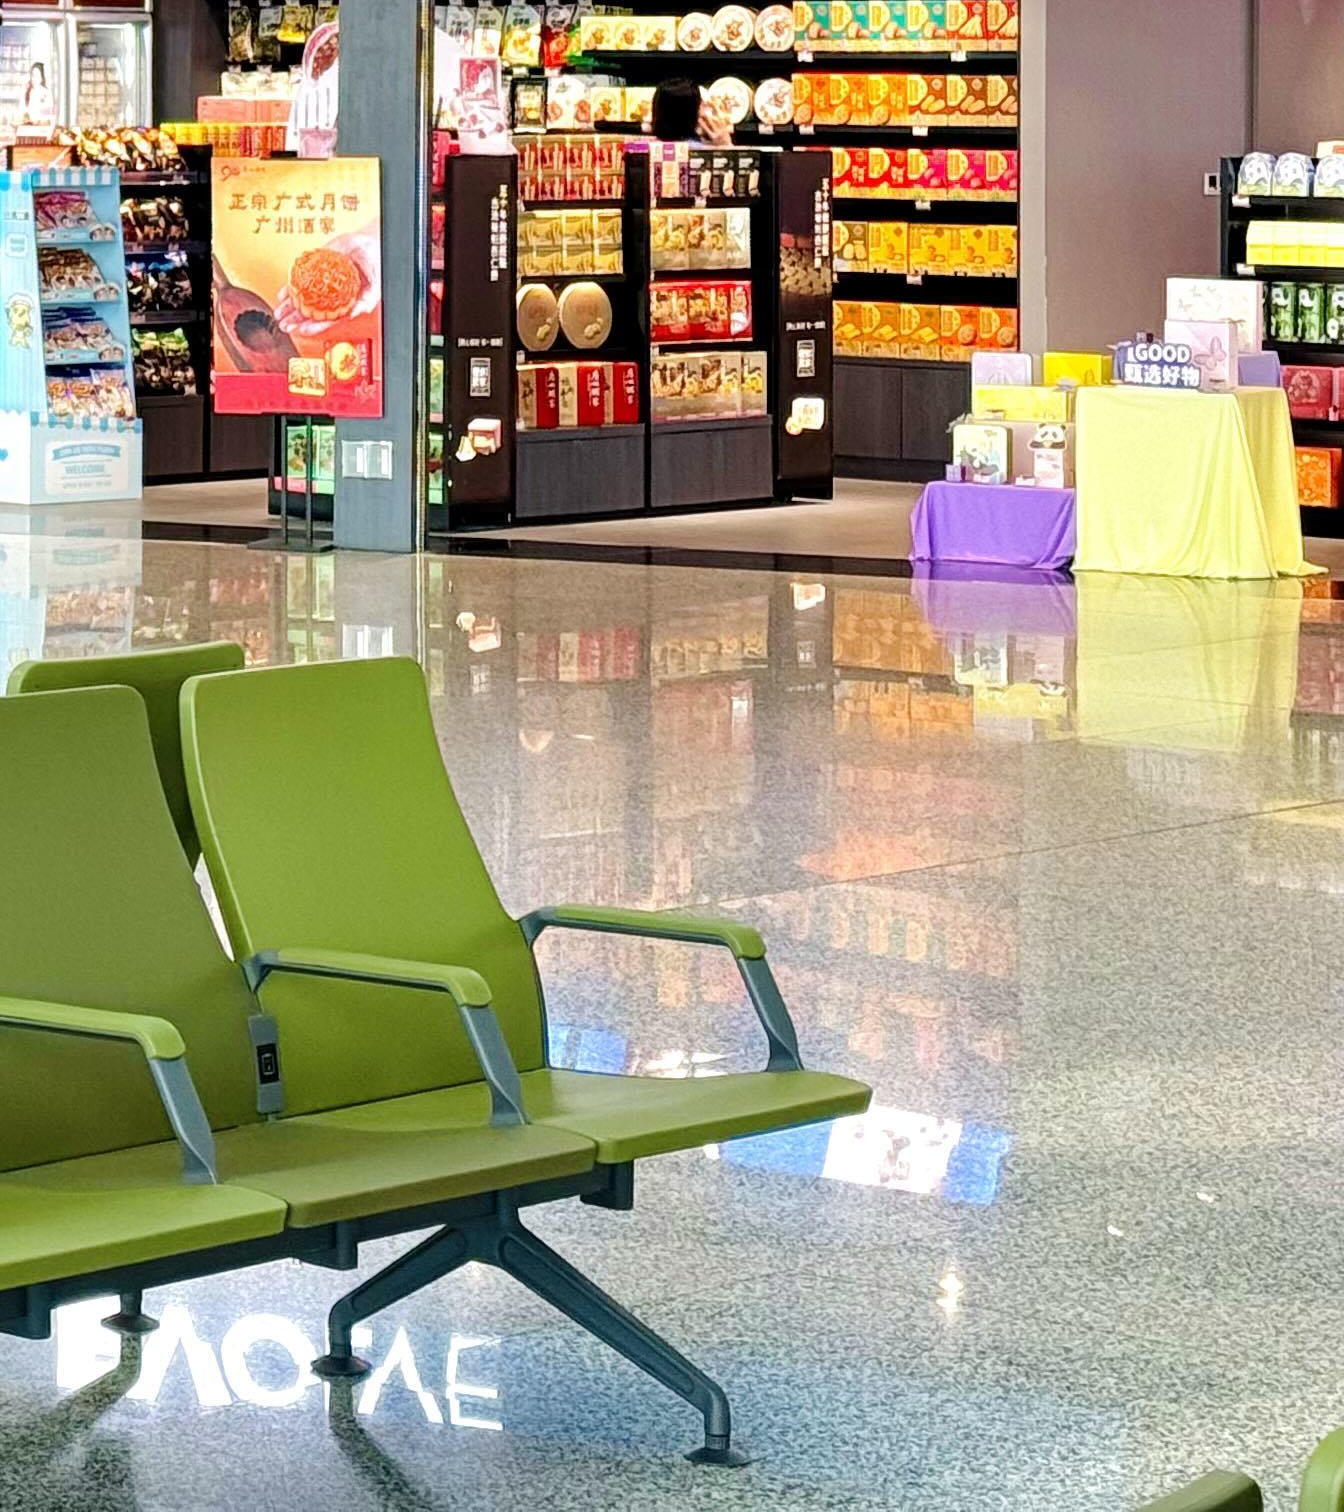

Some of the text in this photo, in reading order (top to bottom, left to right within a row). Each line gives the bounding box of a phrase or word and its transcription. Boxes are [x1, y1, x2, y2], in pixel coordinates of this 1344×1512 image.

[228, 192, 360, 212] 正宗广式月饼
[253, 215, 336, 235] 广州酒家
